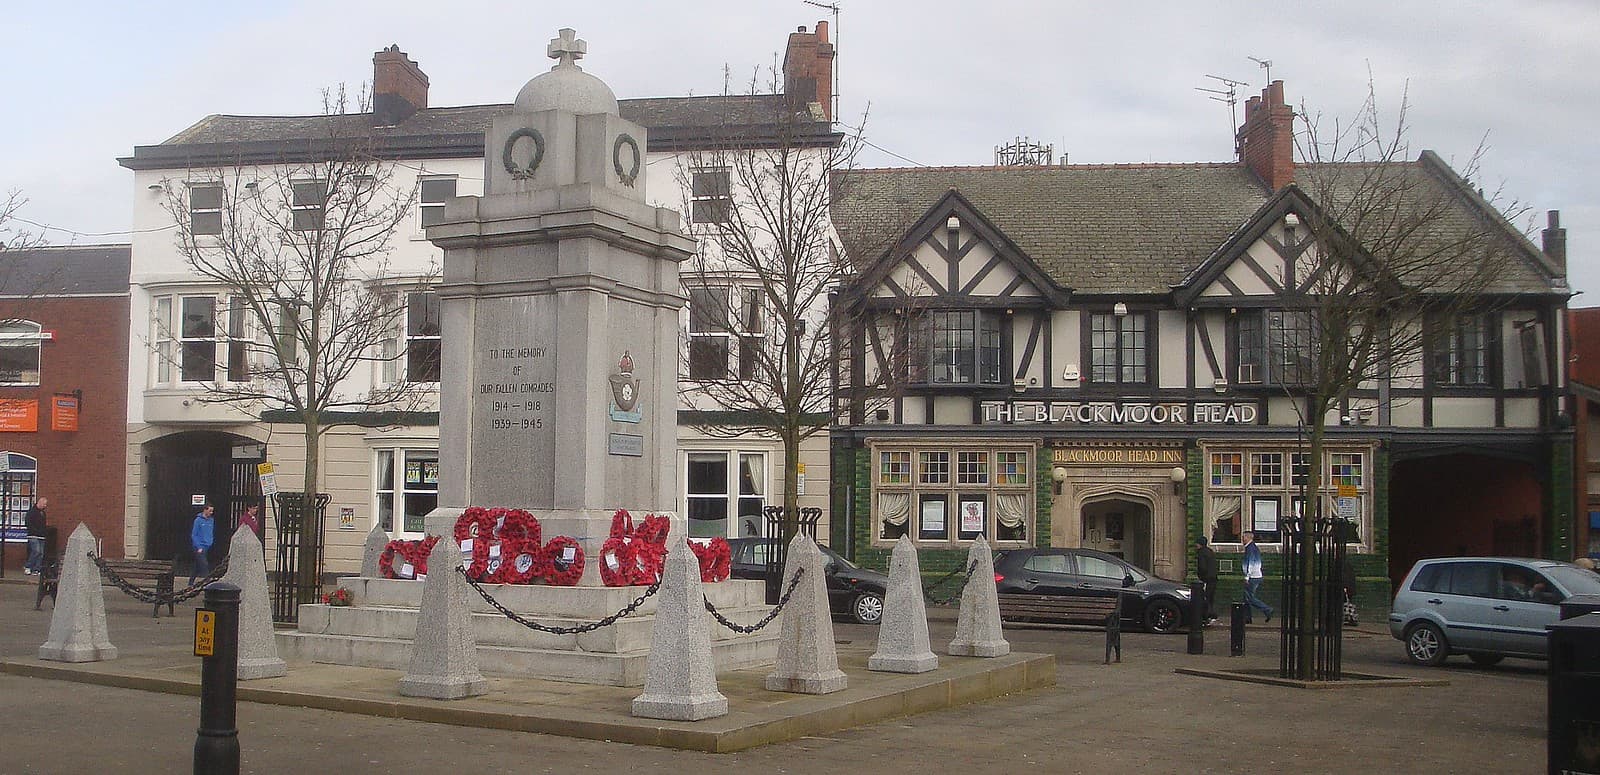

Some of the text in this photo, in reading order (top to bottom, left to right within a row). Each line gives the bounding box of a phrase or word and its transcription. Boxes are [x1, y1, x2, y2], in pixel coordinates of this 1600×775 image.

[490, 347, 546, 359] TO THE MEMORY
[513, 366, 522, 376] OF
[480, 382, 554, 394] OUR FALLEN COMRADES
[492, 401, 508, 411] 1914
[525, 400, 541, 411] 1918
[980, 403, 1257, 424] THE BLACKMOOR HEAD
[1054, 449, 1183, 462] BLACKMOOR HEAD INN
[199, 637, 210, 645] any
